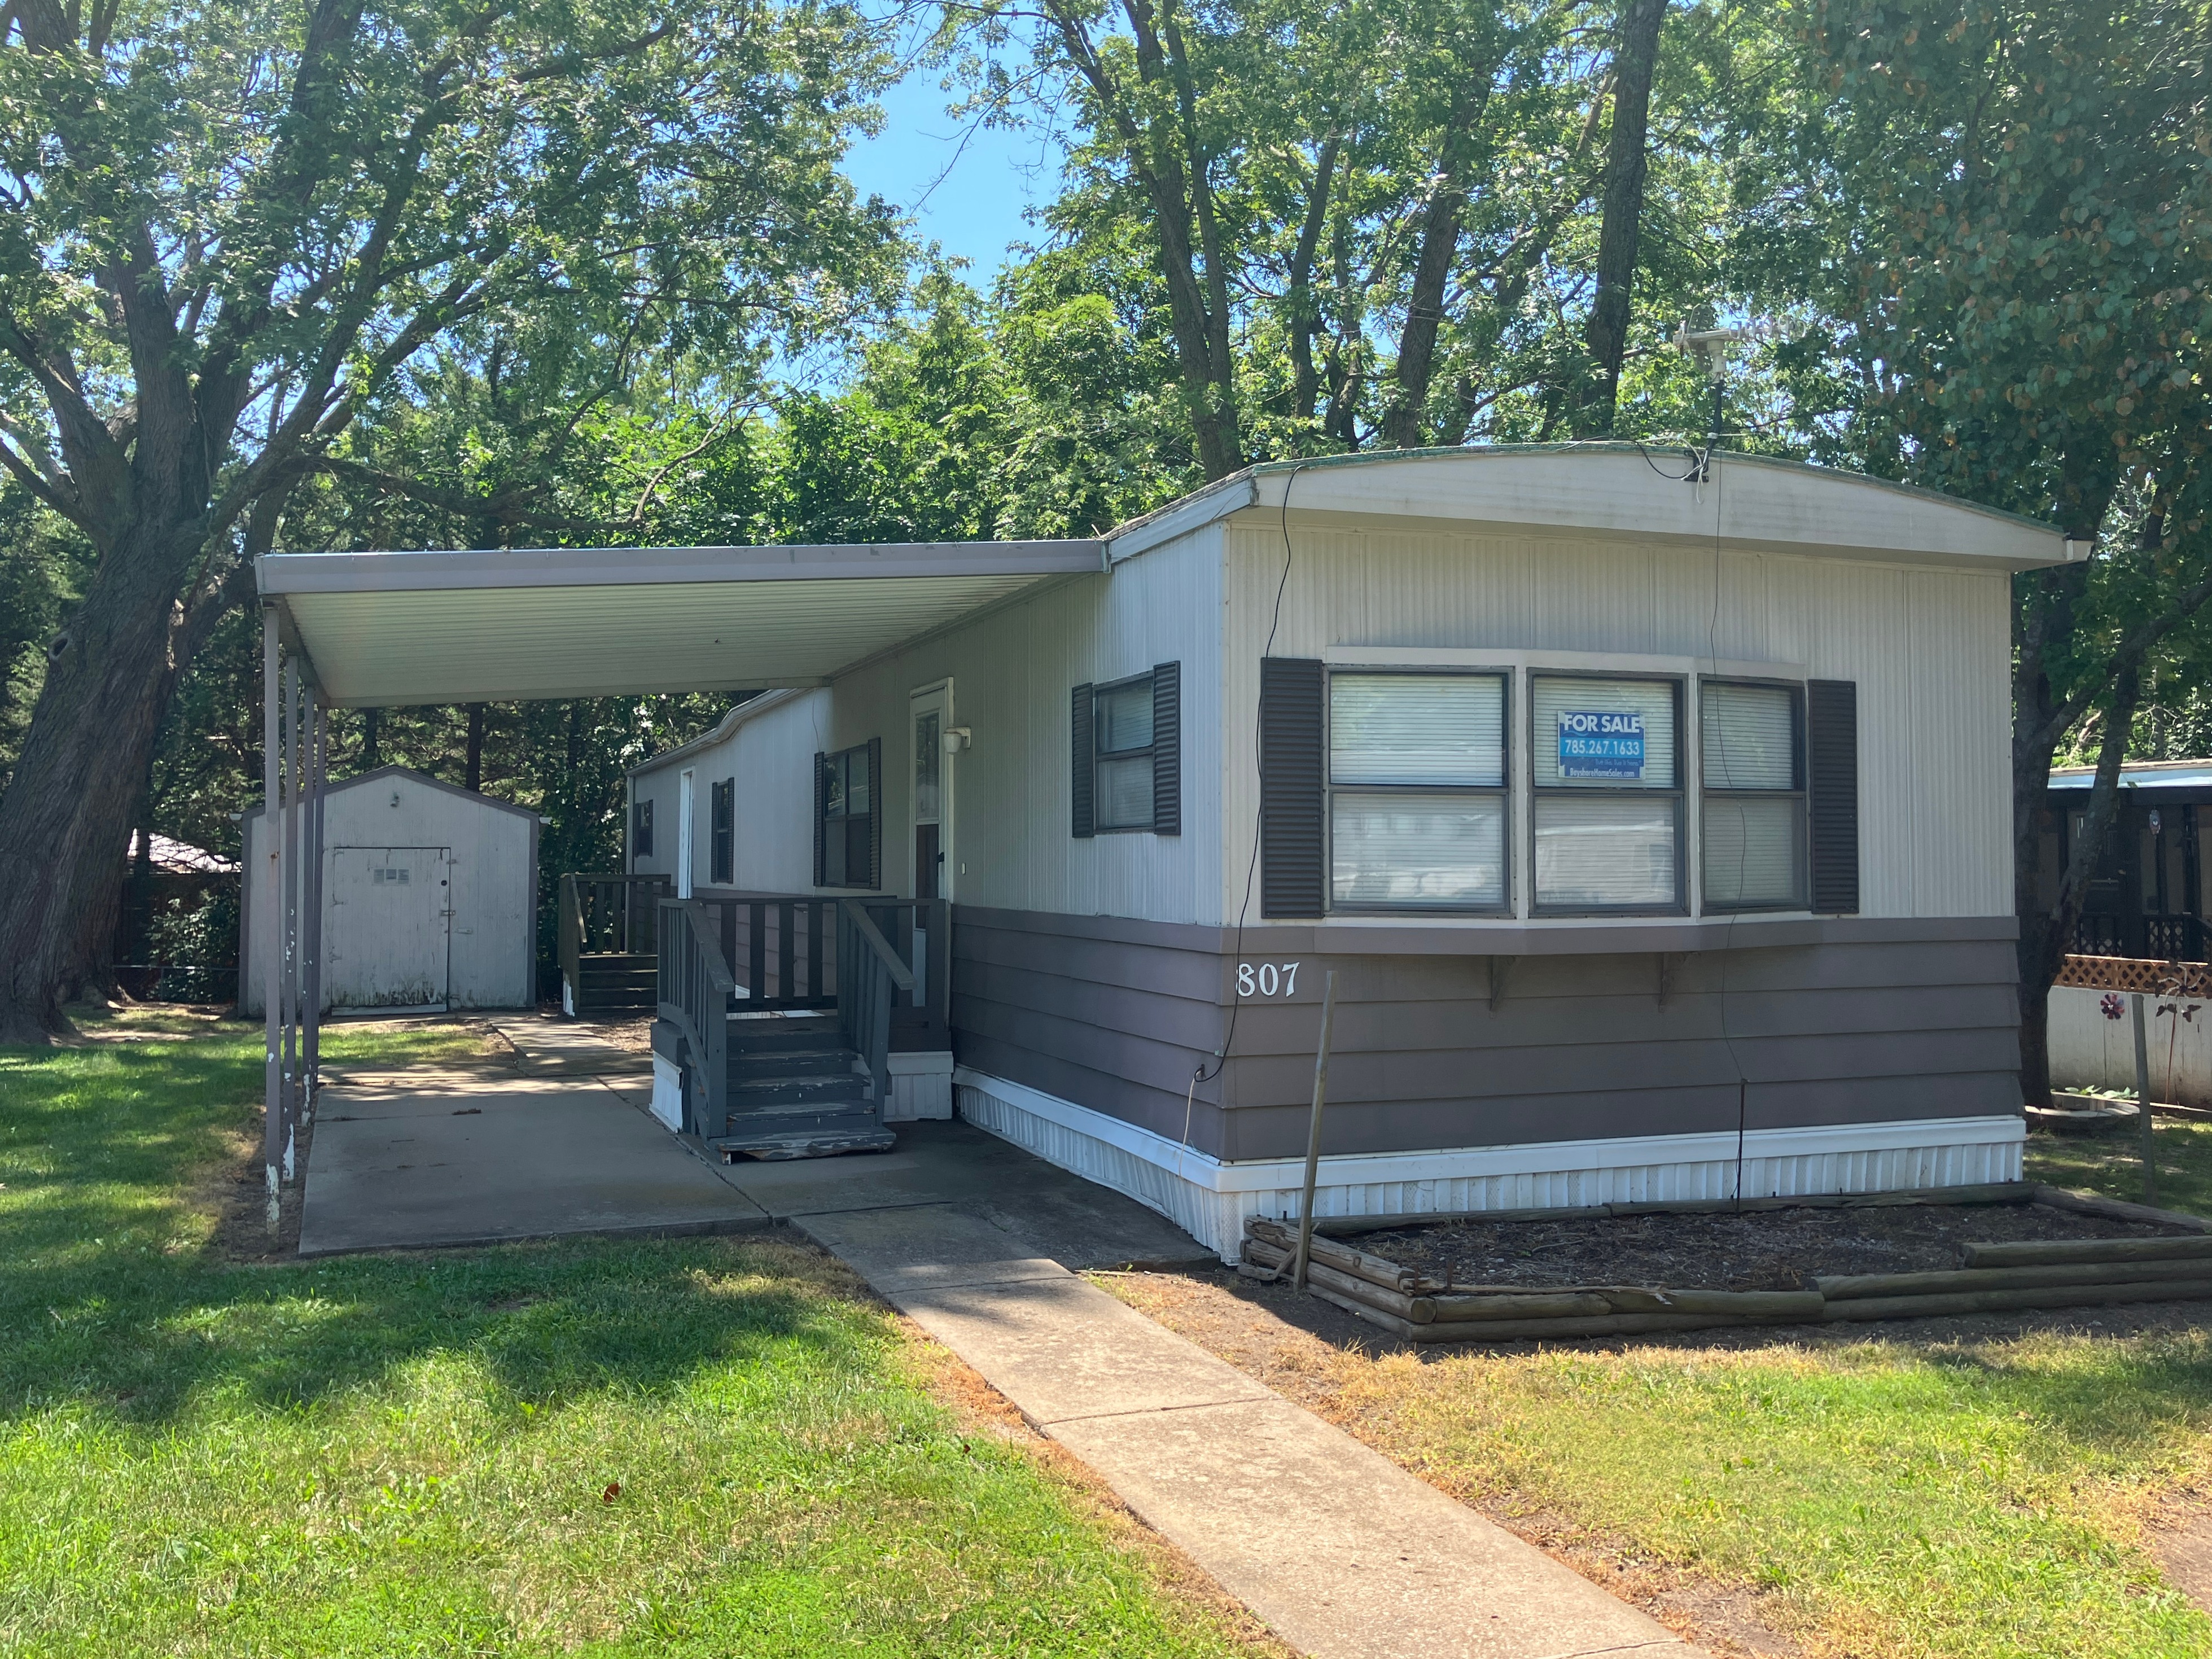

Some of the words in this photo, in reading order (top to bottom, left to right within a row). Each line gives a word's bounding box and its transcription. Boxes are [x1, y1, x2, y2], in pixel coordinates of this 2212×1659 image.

[1564, 715, 1598, 732] FOR
[1601, 716, 1640, 733] SALE
[1565, 739, 1640, 756] 785.267.1633
[1570, 767, 1635, 778] BayshoreHomeSales.com
[1236, 962, 1300, 997] 807
